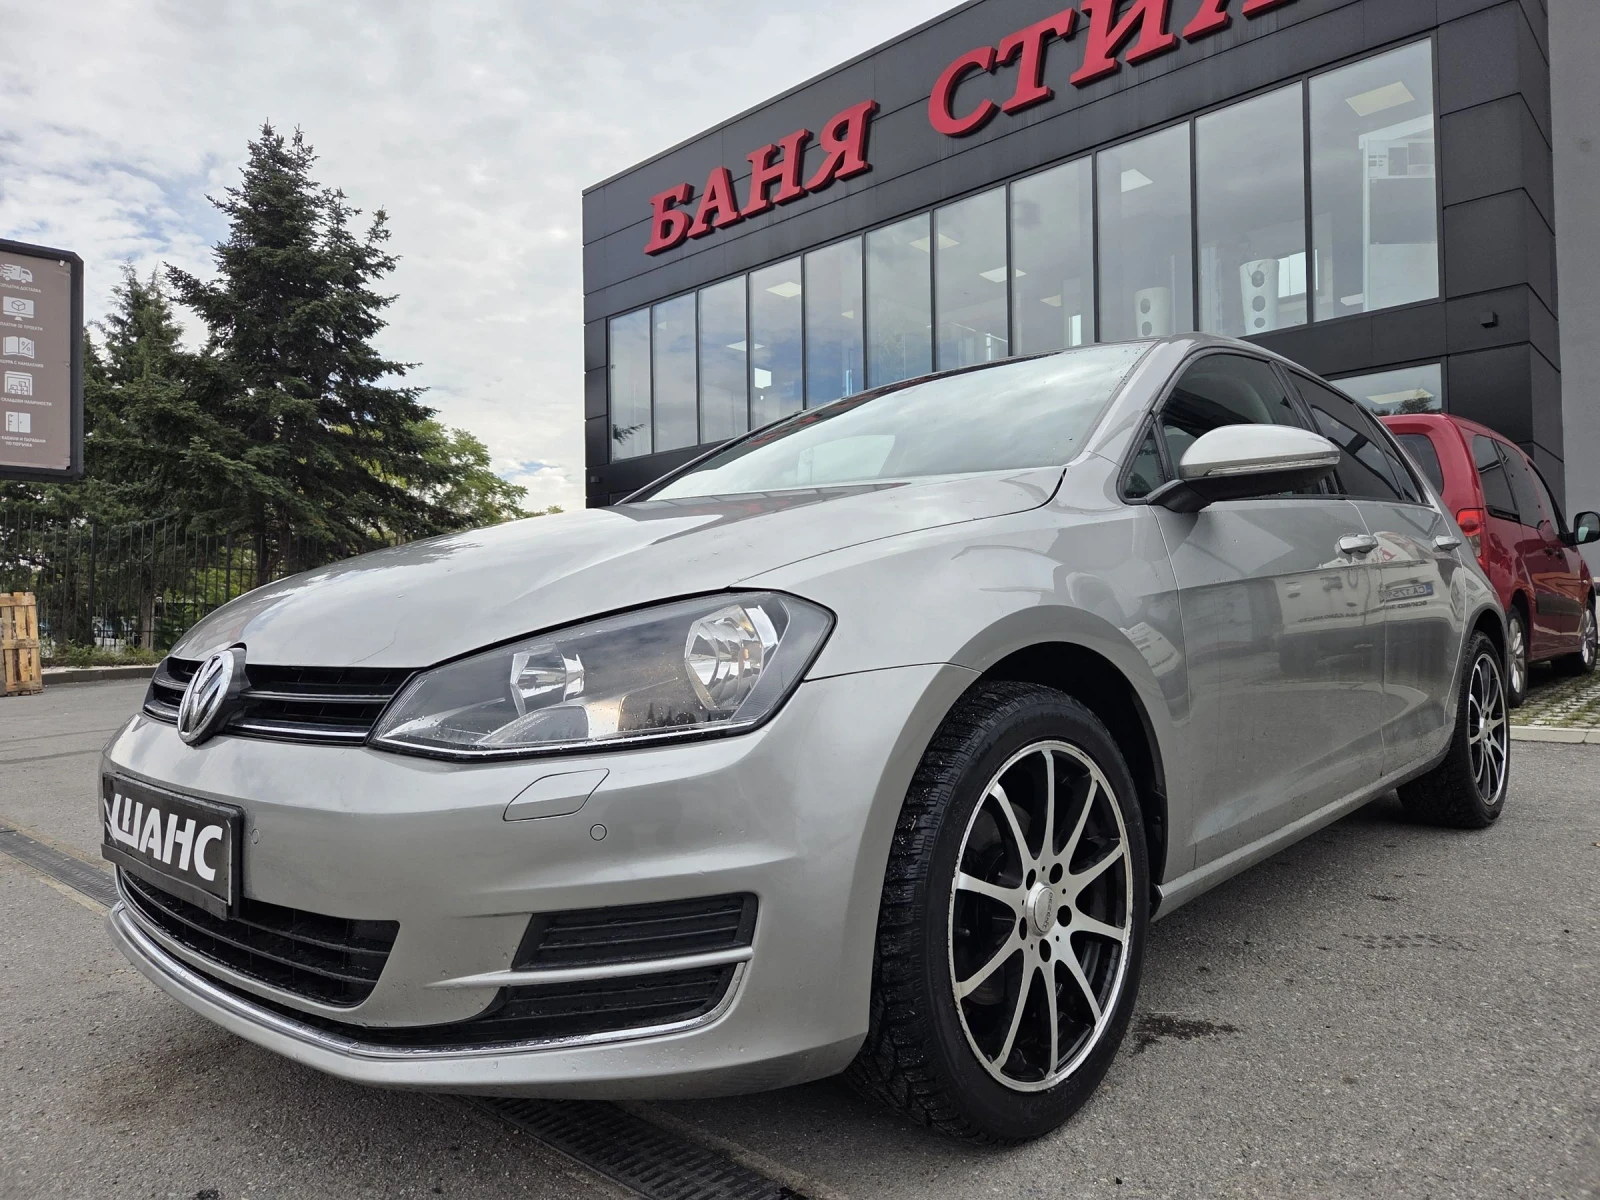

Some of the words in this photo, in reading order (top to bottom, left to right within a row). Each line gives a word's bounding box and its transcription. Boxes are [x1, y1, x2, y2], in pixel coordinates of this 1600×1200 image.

[643, 99, 876, 255] БАНЯ
[928, 0, 1288, 137] СТИ
[111, 793, 223, 881] ШАНС
